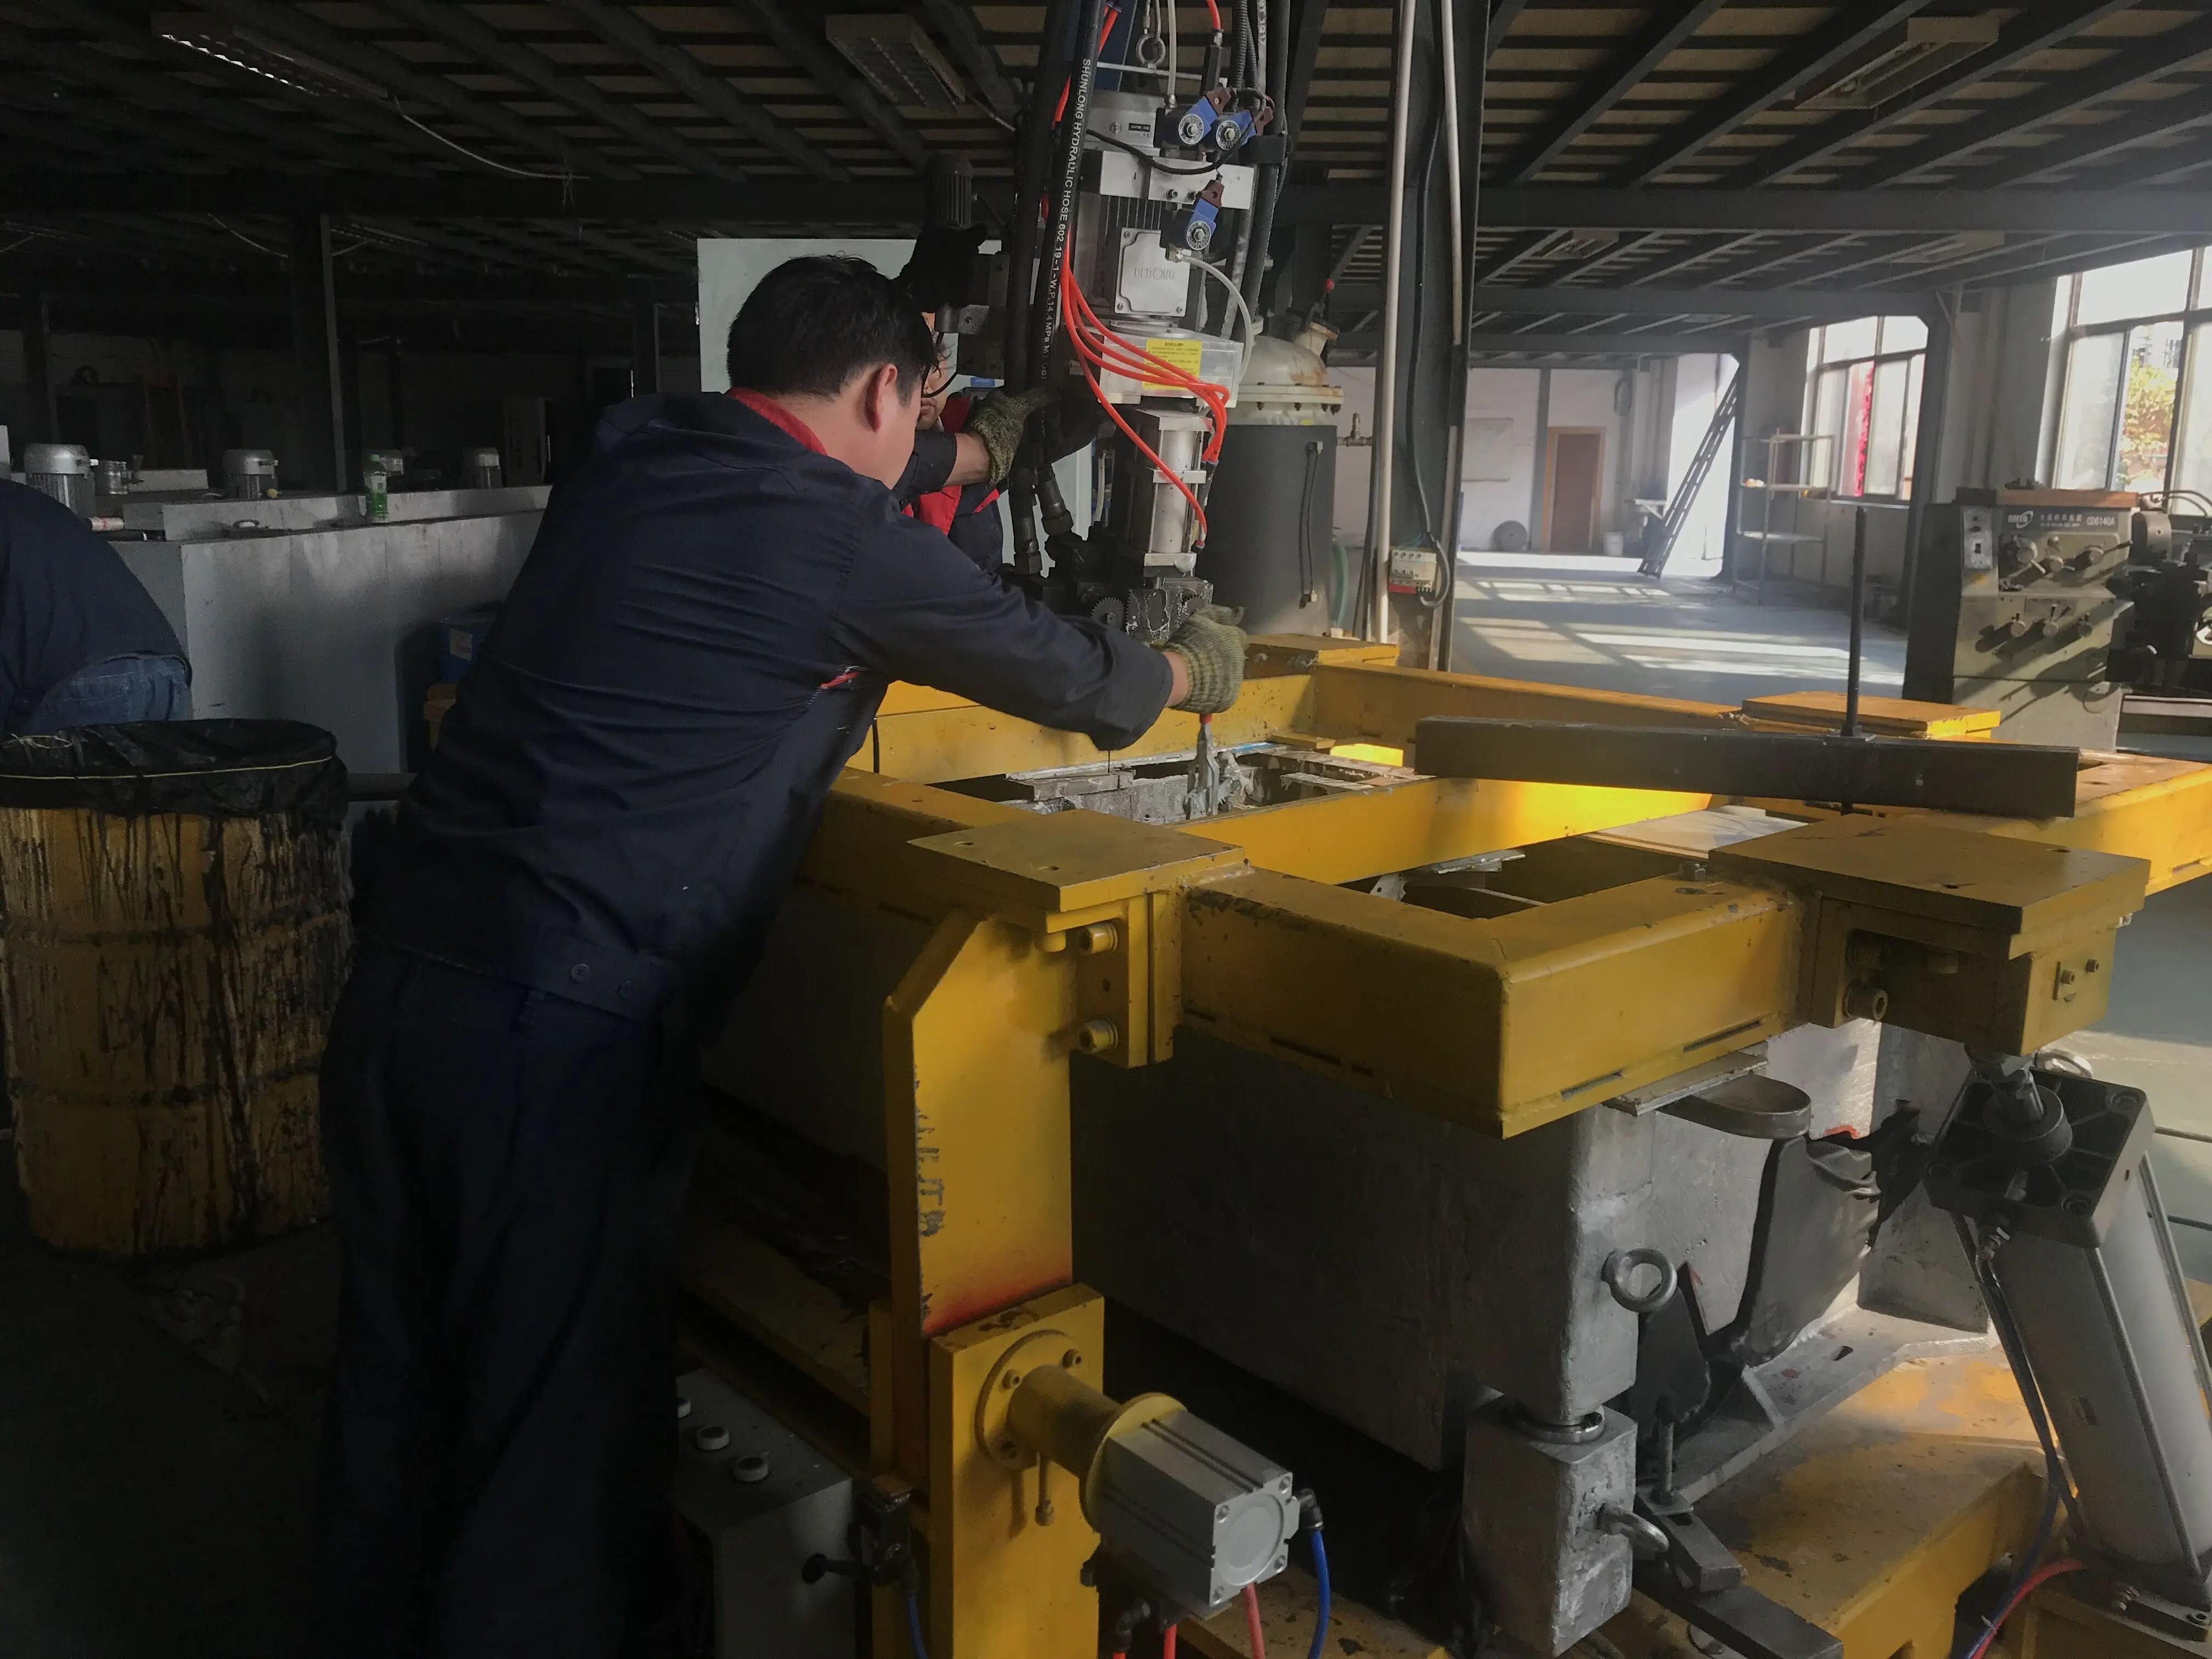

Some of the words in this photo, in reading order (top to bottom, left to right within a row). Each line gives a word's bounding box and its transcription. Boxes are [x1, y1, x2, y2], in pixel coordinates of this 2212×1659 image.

[1075, 59, 1091, 119] SHUNLONG
[1064, 122, 1082, 188] HYDRAULIC
[1059, 190, 1071, 221] HOSE
[1056, 223, 1066, 242] 602
